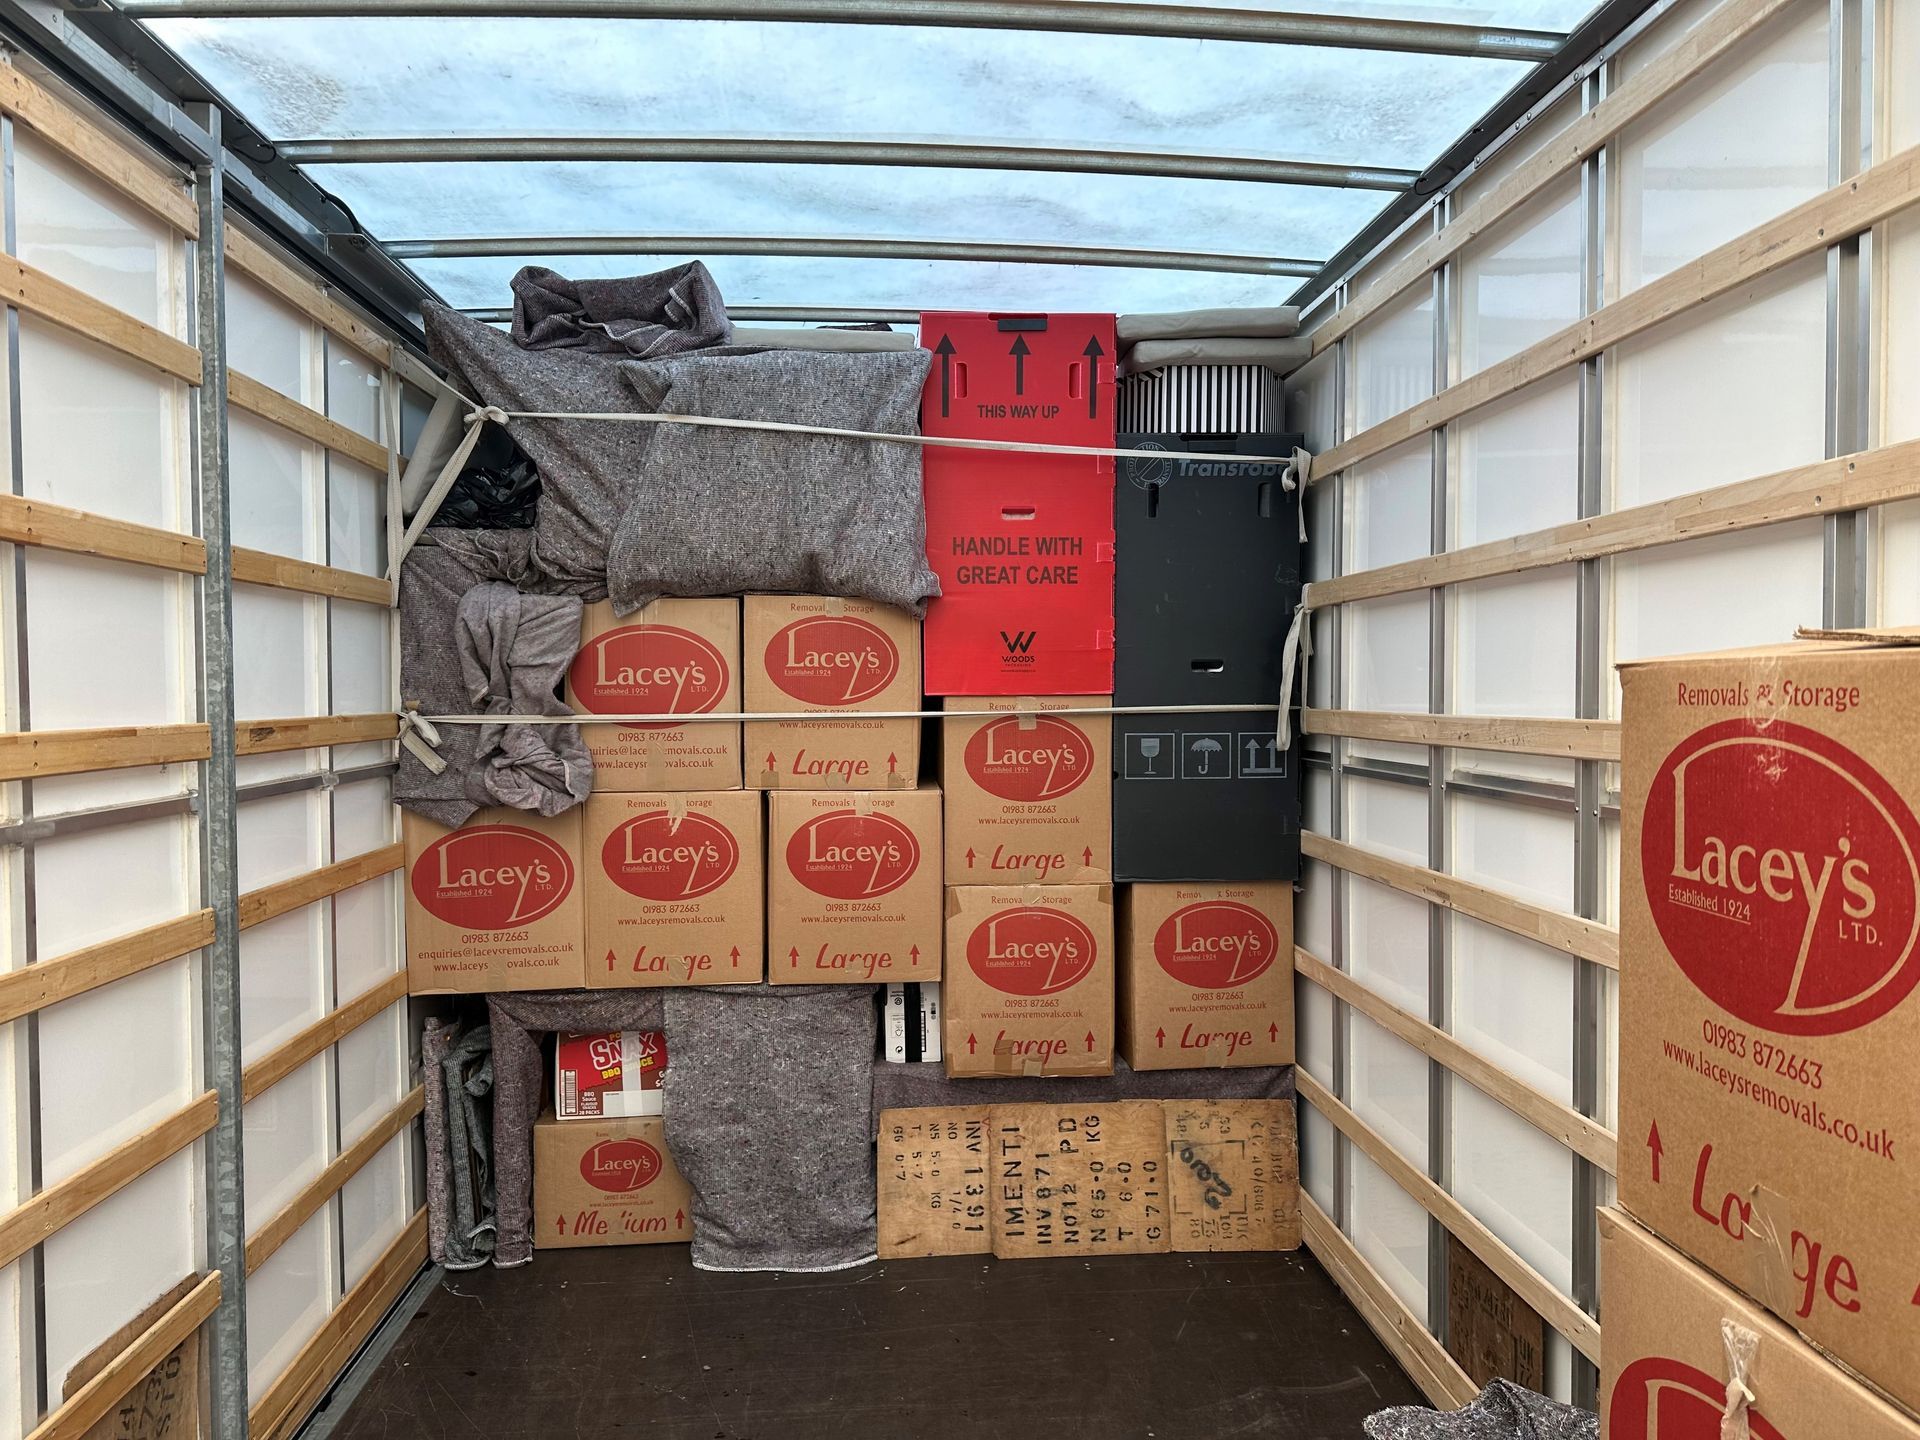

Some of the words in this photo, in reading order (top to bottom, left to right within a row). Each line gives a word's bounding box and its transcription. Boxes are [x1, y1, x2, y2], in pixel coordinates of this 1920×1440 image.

[977, 405, 1006, 418] THIS
[1010, 405, 1038, 418] WAY
[1042, 406, 1059, 418] UP
[952, 537, 1029, 555] HANDLE
[1036, 537, 1082, 555] WITH
[957, 566, 1020, 584] GREAT
[1026, 566, 1078, 584] CARE
[791, 604, 825, 612] Removal
[844, 604, 875, 614] Storage
[785, 630, 880, 700] Lacey's
[596, 641, 705, 713] Lacey's
[1678, 682, 1749, 706] Removals
[1783, 680, 1860, 712] Storage
[1040, 703, 1070, 711] Storage
[779, 721, 884, 730] www.laceysremovals.co.uk
[618, 733, 645, 741] 01983
[649, 732, 684, 741] 872663
[792, 749, 869, 784] Large
[985, 729, 1075, 796] Lacey's
[686, 799, 712, 807] torage
[812, 799, 850, 807] Removals
[872, 799, 895, 808] orage
[1028, 805, 1056, 813] 872663
[978, 816, 1080, 826] www.laceysremovals.co.uk
[624, 825, 720, 895] Lacey's
[808, 826, 900, 894] Lacey's
[991, 844, 1065, 880] Large
[437, 846, 550, 922] Lacey's
[1225, 890, 1254, 898] Storage
[1671, 764, 1876, 1014] Lacey's
[643, 905, 666, 914] 01983
[670, 904, 700, 913] 872663
[826, 904, 848, 912] 01983
[852, 903, 881, 912] 872663
[991, 896, 1022, 904] Remova
[1042, 896, 1072, 904] Storage
[1669, 884, 1718, 912] Established
[1723, 898, 1751, 921] 1924
[618, 915, 725, 926] www.laceysremovals.co.uk
[801, 914, 906, 924] www.laceysremovals.co.uk
[462, 934, 489, 944] 01983
[493, 932, 529, 942] 872663
[1839, 919, 1883, 946] LTD.
[987, 922, 1078, 990] Lacey's
[1175, 917, 1260, 982] Lacey's
[434, 957, 560, 972] www.laceysovals.co.uk
[633, 946, 712, 981] Lage
[816, 943, 892, 979] Large
[1030, 999, 1059, 1007] 872663
[1192, 993, 1213, 1001] 01983
[1216, 992, 1243, 1000] 872663
[981, 1010, 1083, 1019] www.laceysremovals.co.uk
[1169, 1002, 1267, 1013] www.laceysremovals.co.uk
[1181, 1023, 1252, 1057] Large
[1703, 1019, 1746, 1058] 01983
[1753, 1040, 1824, 1089] 872663
[602, 1067, 621, 1079] BBQ
[1663, 1040, 1895, 1161] www.laceysremovals.co.uk
[965, 1121, 981, 1152] INV
[1085, 1115, 1100, 1142] KG
[593, 1148, 651, 1188] Lacey's
[574, 1210, 667, 1235] Meium
[1693, 1143, 1861, 1318] Lage
